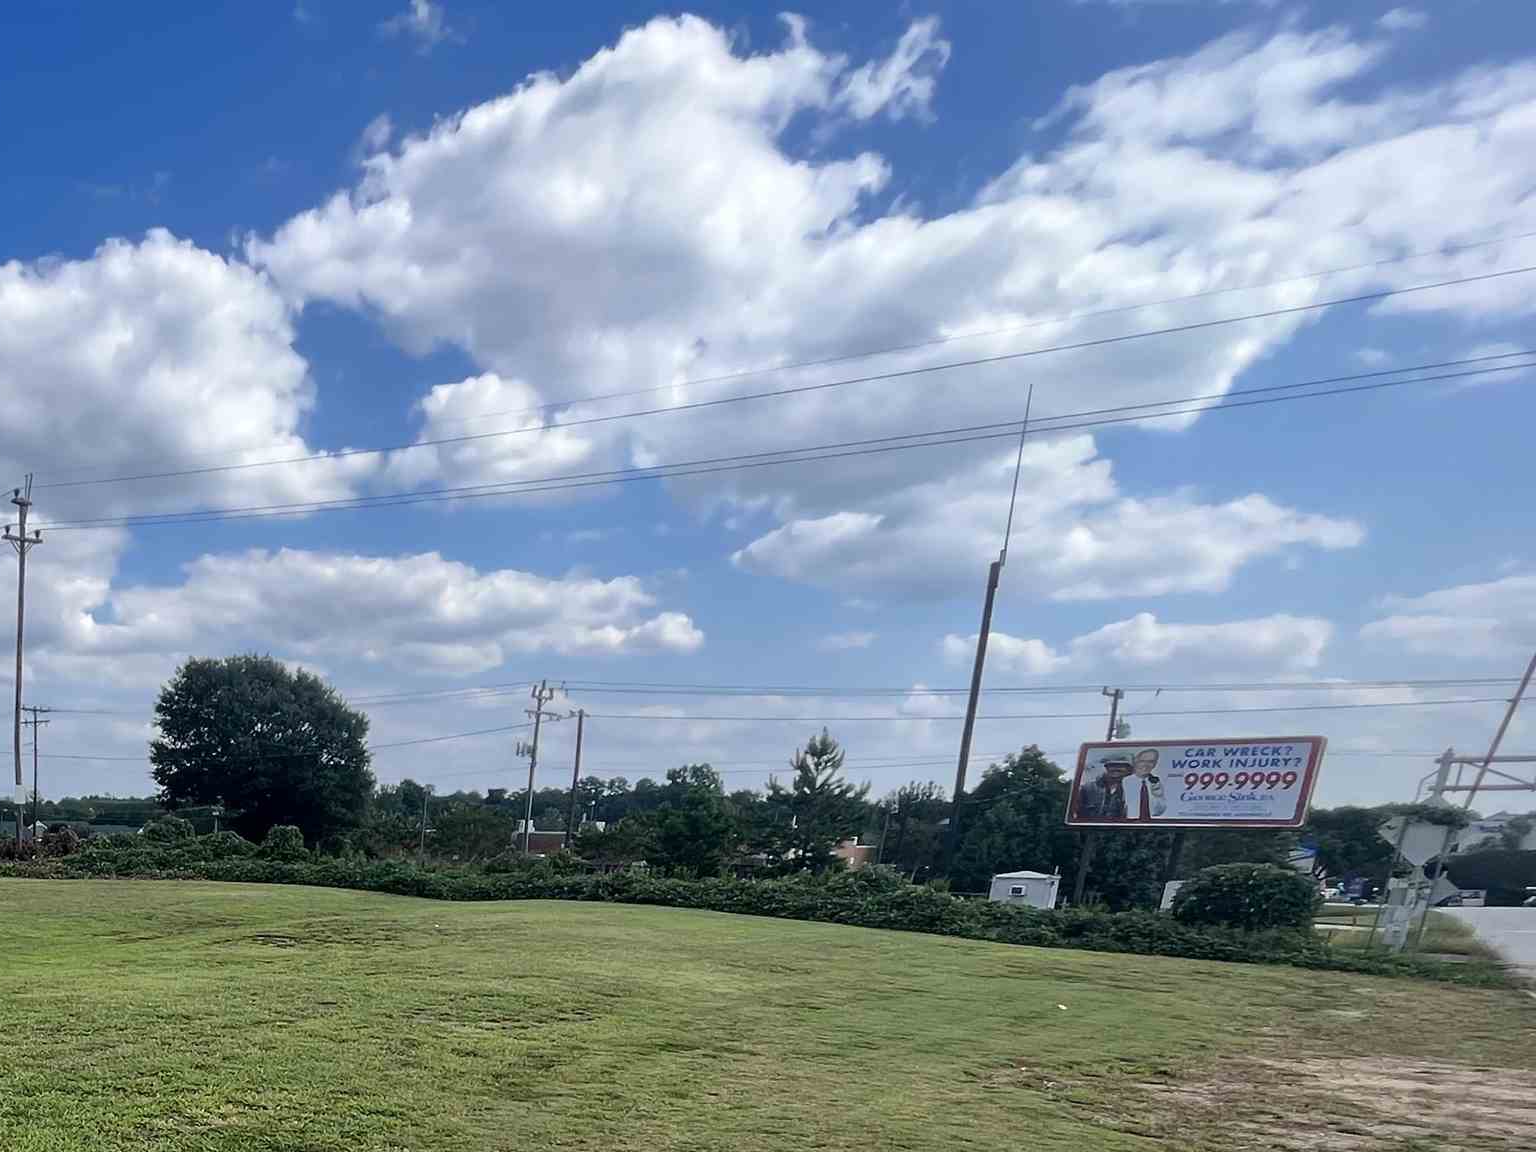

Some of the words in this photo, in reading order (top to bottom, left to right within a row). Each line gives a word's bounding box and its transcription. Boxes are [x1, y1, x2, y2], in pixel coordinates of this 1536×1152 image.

[1185, 747, 1216, 757] CAR
[1224, 746, 1293, 757] WRECK?
[1171, 758, 1221, 769] WORK
[1230, 758, 1302, 768] INJURY?
[1184, 772, 1298, 790] 999-9999
